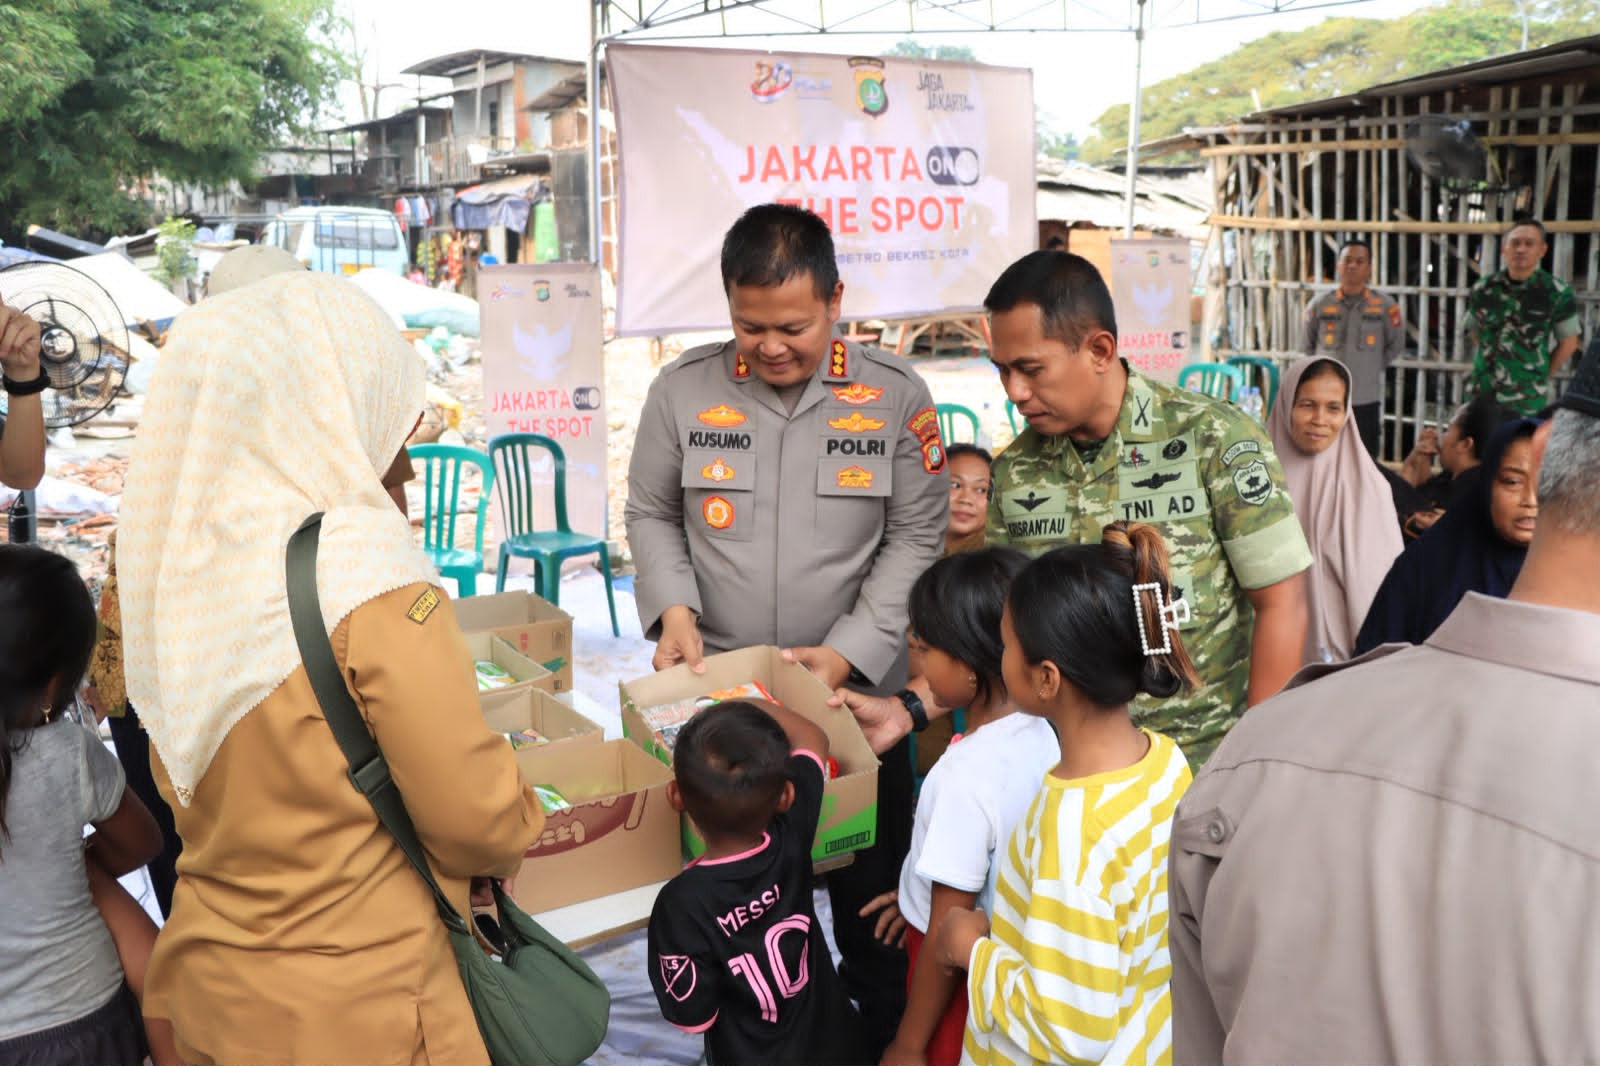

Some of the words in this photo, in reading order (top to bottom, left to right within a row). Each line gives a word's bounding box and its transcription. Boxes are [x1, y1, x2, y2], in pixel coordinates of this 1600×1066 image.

[917, 70, 943, 91] JAGA
[738, 145, 923, 183] JAKARTA
[928, 156, 955, 177] ON
[871, 196, 965, 233] SPOT
[491, 389, 571, 413] JAKARTA
[545, 415, 593, 438] SPOT
[688, 431, 752, 450] KUSUMO
[826, 438, 886, 456] POLRI
[1121, 499, 1154, 521] TNI
[1167, 495, 1195, 515] AD
[716, 884, 781, 938] MESSI
[727, 913, 812, 1024] 10
